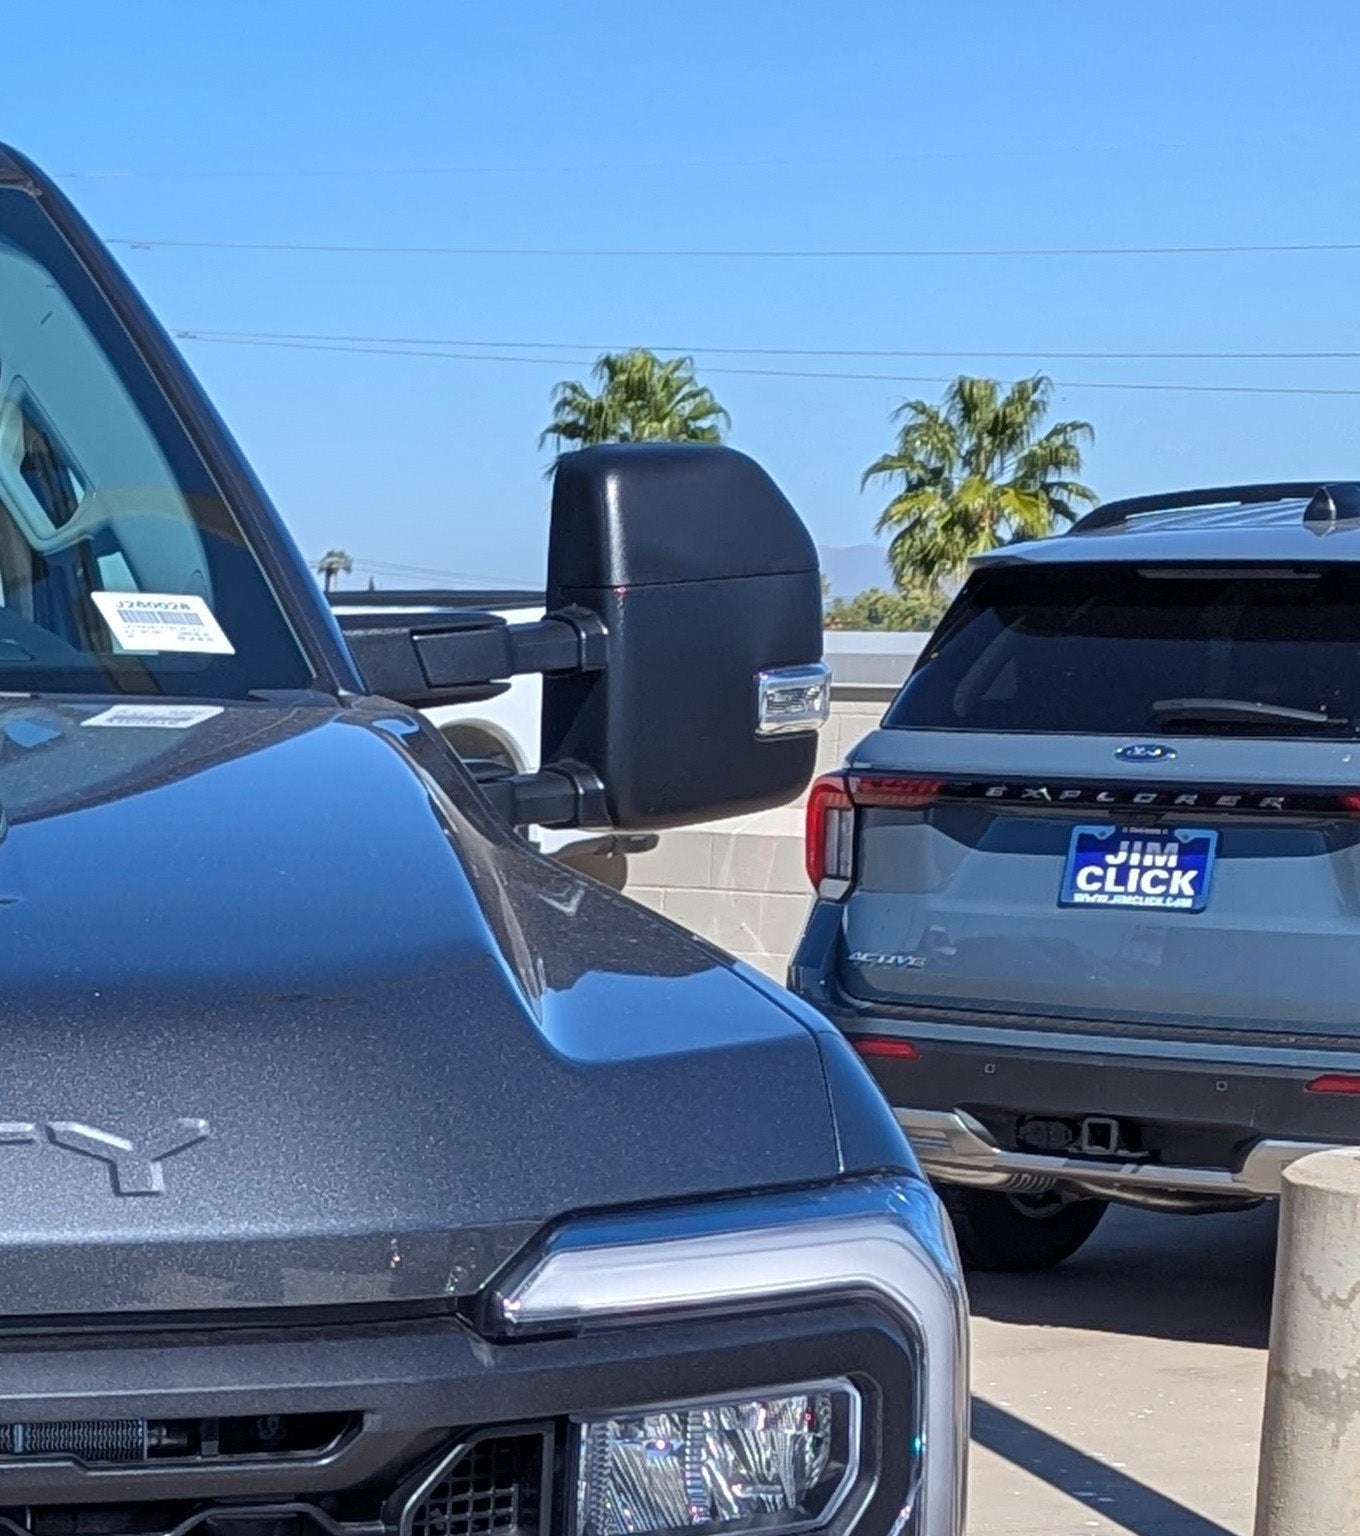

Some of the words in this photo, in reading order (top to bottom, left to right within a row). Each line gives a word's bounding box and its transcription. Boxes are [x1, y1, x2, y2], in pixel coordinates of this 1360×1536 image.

[985, 785, 1285, 811] EXPLORER
[1105, 840, 1179, 868] JIM
[1076, 866, 1198, 896] CLICK
[848, 951, 927, 967] ACTIVE
